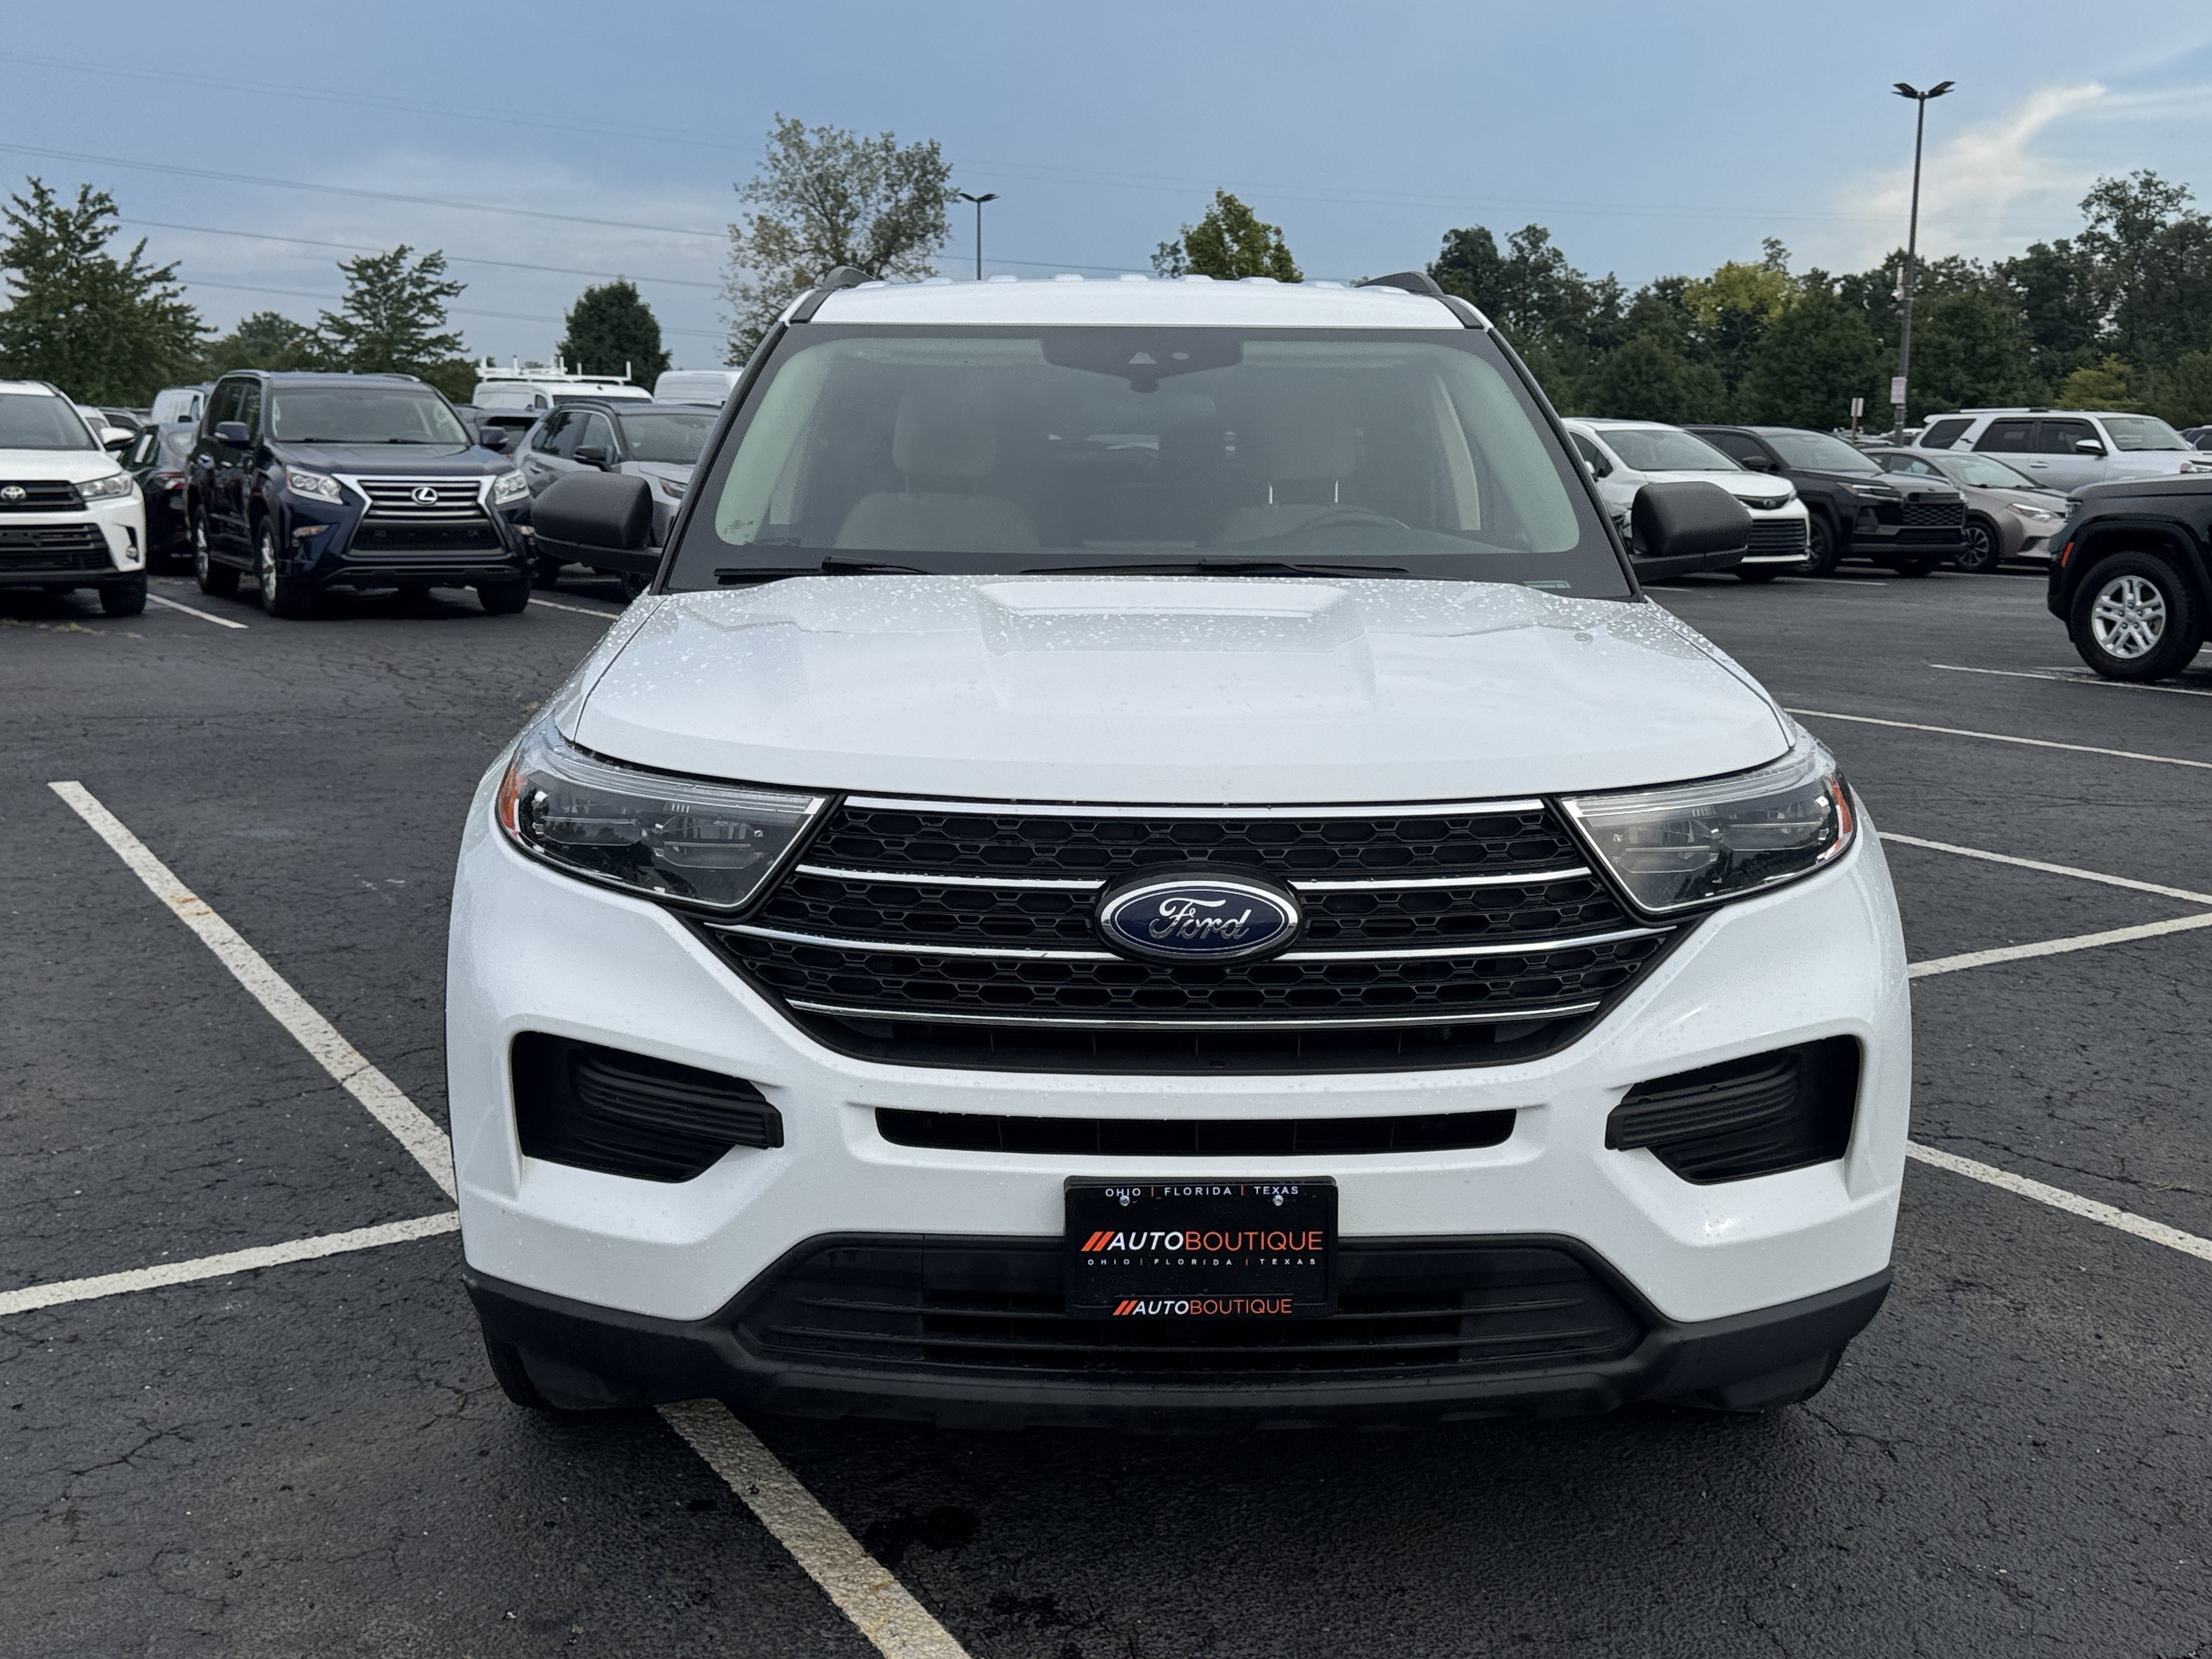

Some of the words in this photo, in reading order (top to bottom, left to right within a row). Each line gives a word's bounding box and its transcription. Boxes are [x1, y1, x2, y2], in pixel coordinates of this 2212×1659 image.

[1148, 897, 1252, 939] Ford
[1105, 1187, 1141, 1197] OHIO
[1164, 1186, 1232, 1196] FLORIDA
[1254, 1186, 1299, 1195] TEXAS
